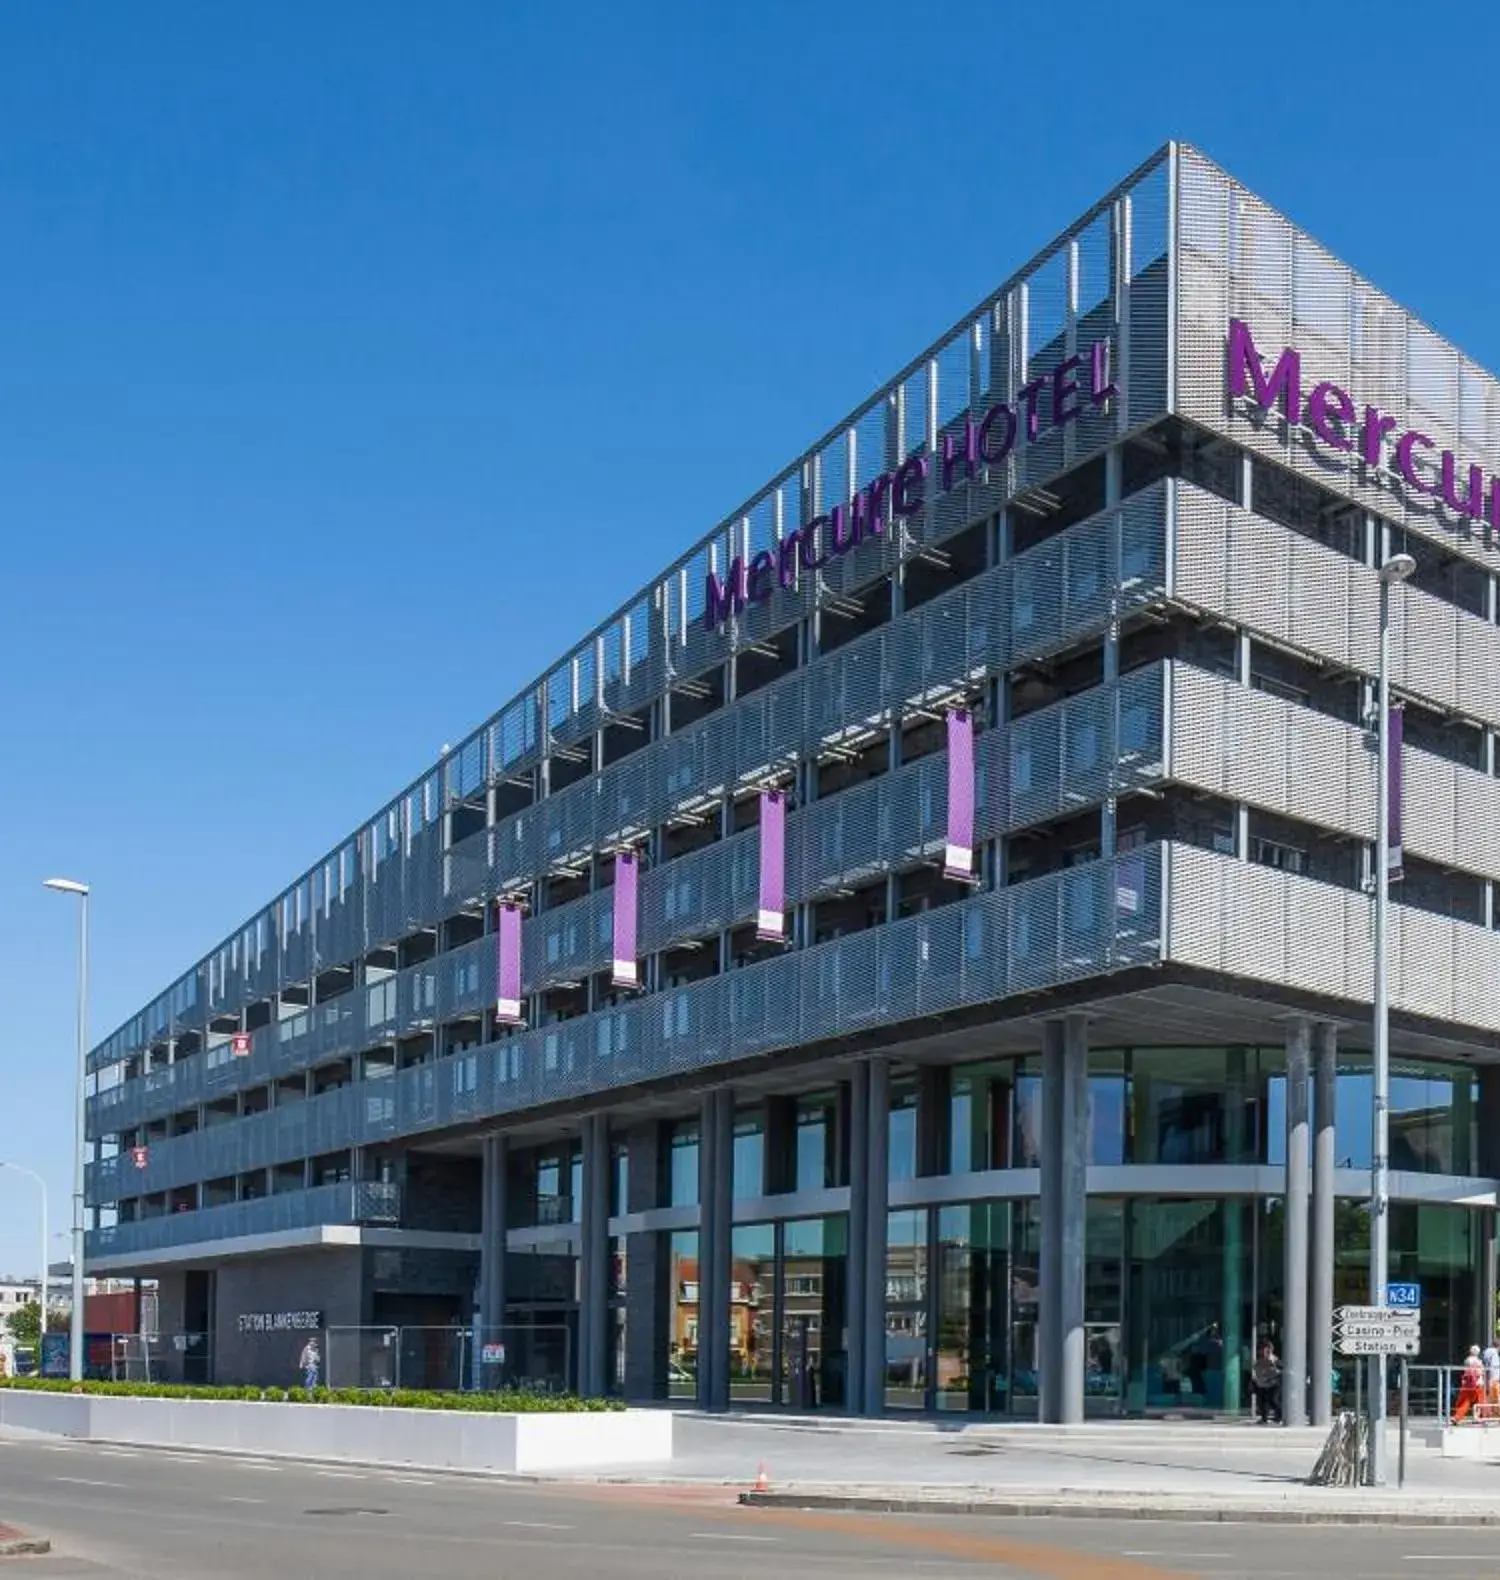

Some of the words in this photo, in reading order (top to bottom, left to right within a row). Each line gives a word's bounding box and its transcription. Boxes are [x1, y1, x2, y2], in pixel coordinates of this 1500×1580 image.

[704, 455, 929, 632] Mercure
[942, 341, 1121, 491] HOTEL
[1389, 1287, 1415, 1303] N34
[1355, 1341, 1397, 1352] Station
